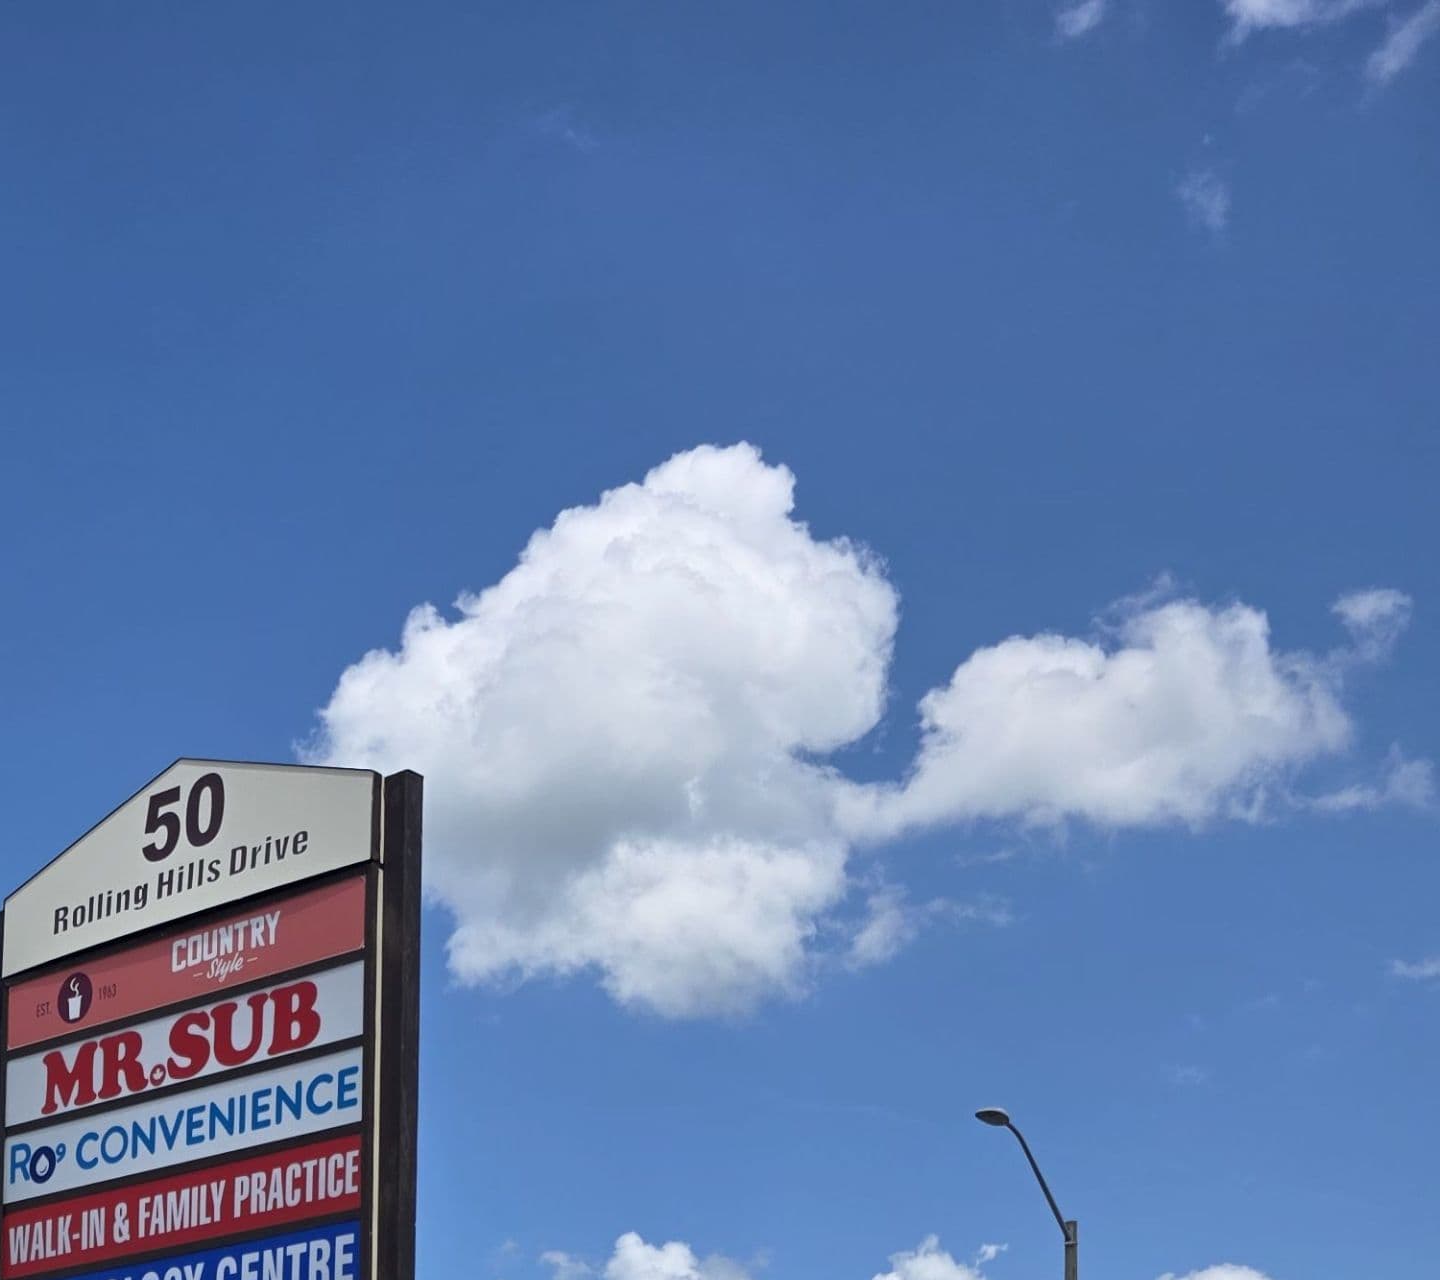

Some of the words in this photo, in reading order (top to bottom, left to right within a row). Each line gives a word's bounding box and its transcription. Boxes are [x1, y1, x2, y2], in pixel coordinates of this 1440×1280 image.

[142, 772, 225, 862] 50
[53, 882, 148, 935] Rolling
[157, 859, 221, 900] Hills
[230, 830, 309, 876] Drive
[171, 911, 280, 973] COUNTRY
[206, 957, 245, 983] Style
[99, 983, 117, 1001] 1963
[76, 1065, 359, 1170] CONVENIENCE
[9, 1206, 105, 1266] WALK-IN
[113, 1201, 130, 1242] &
[138, 1179, 226, 1234] FAMILY
[233, 1150, 360, 1218] PRACTICE
